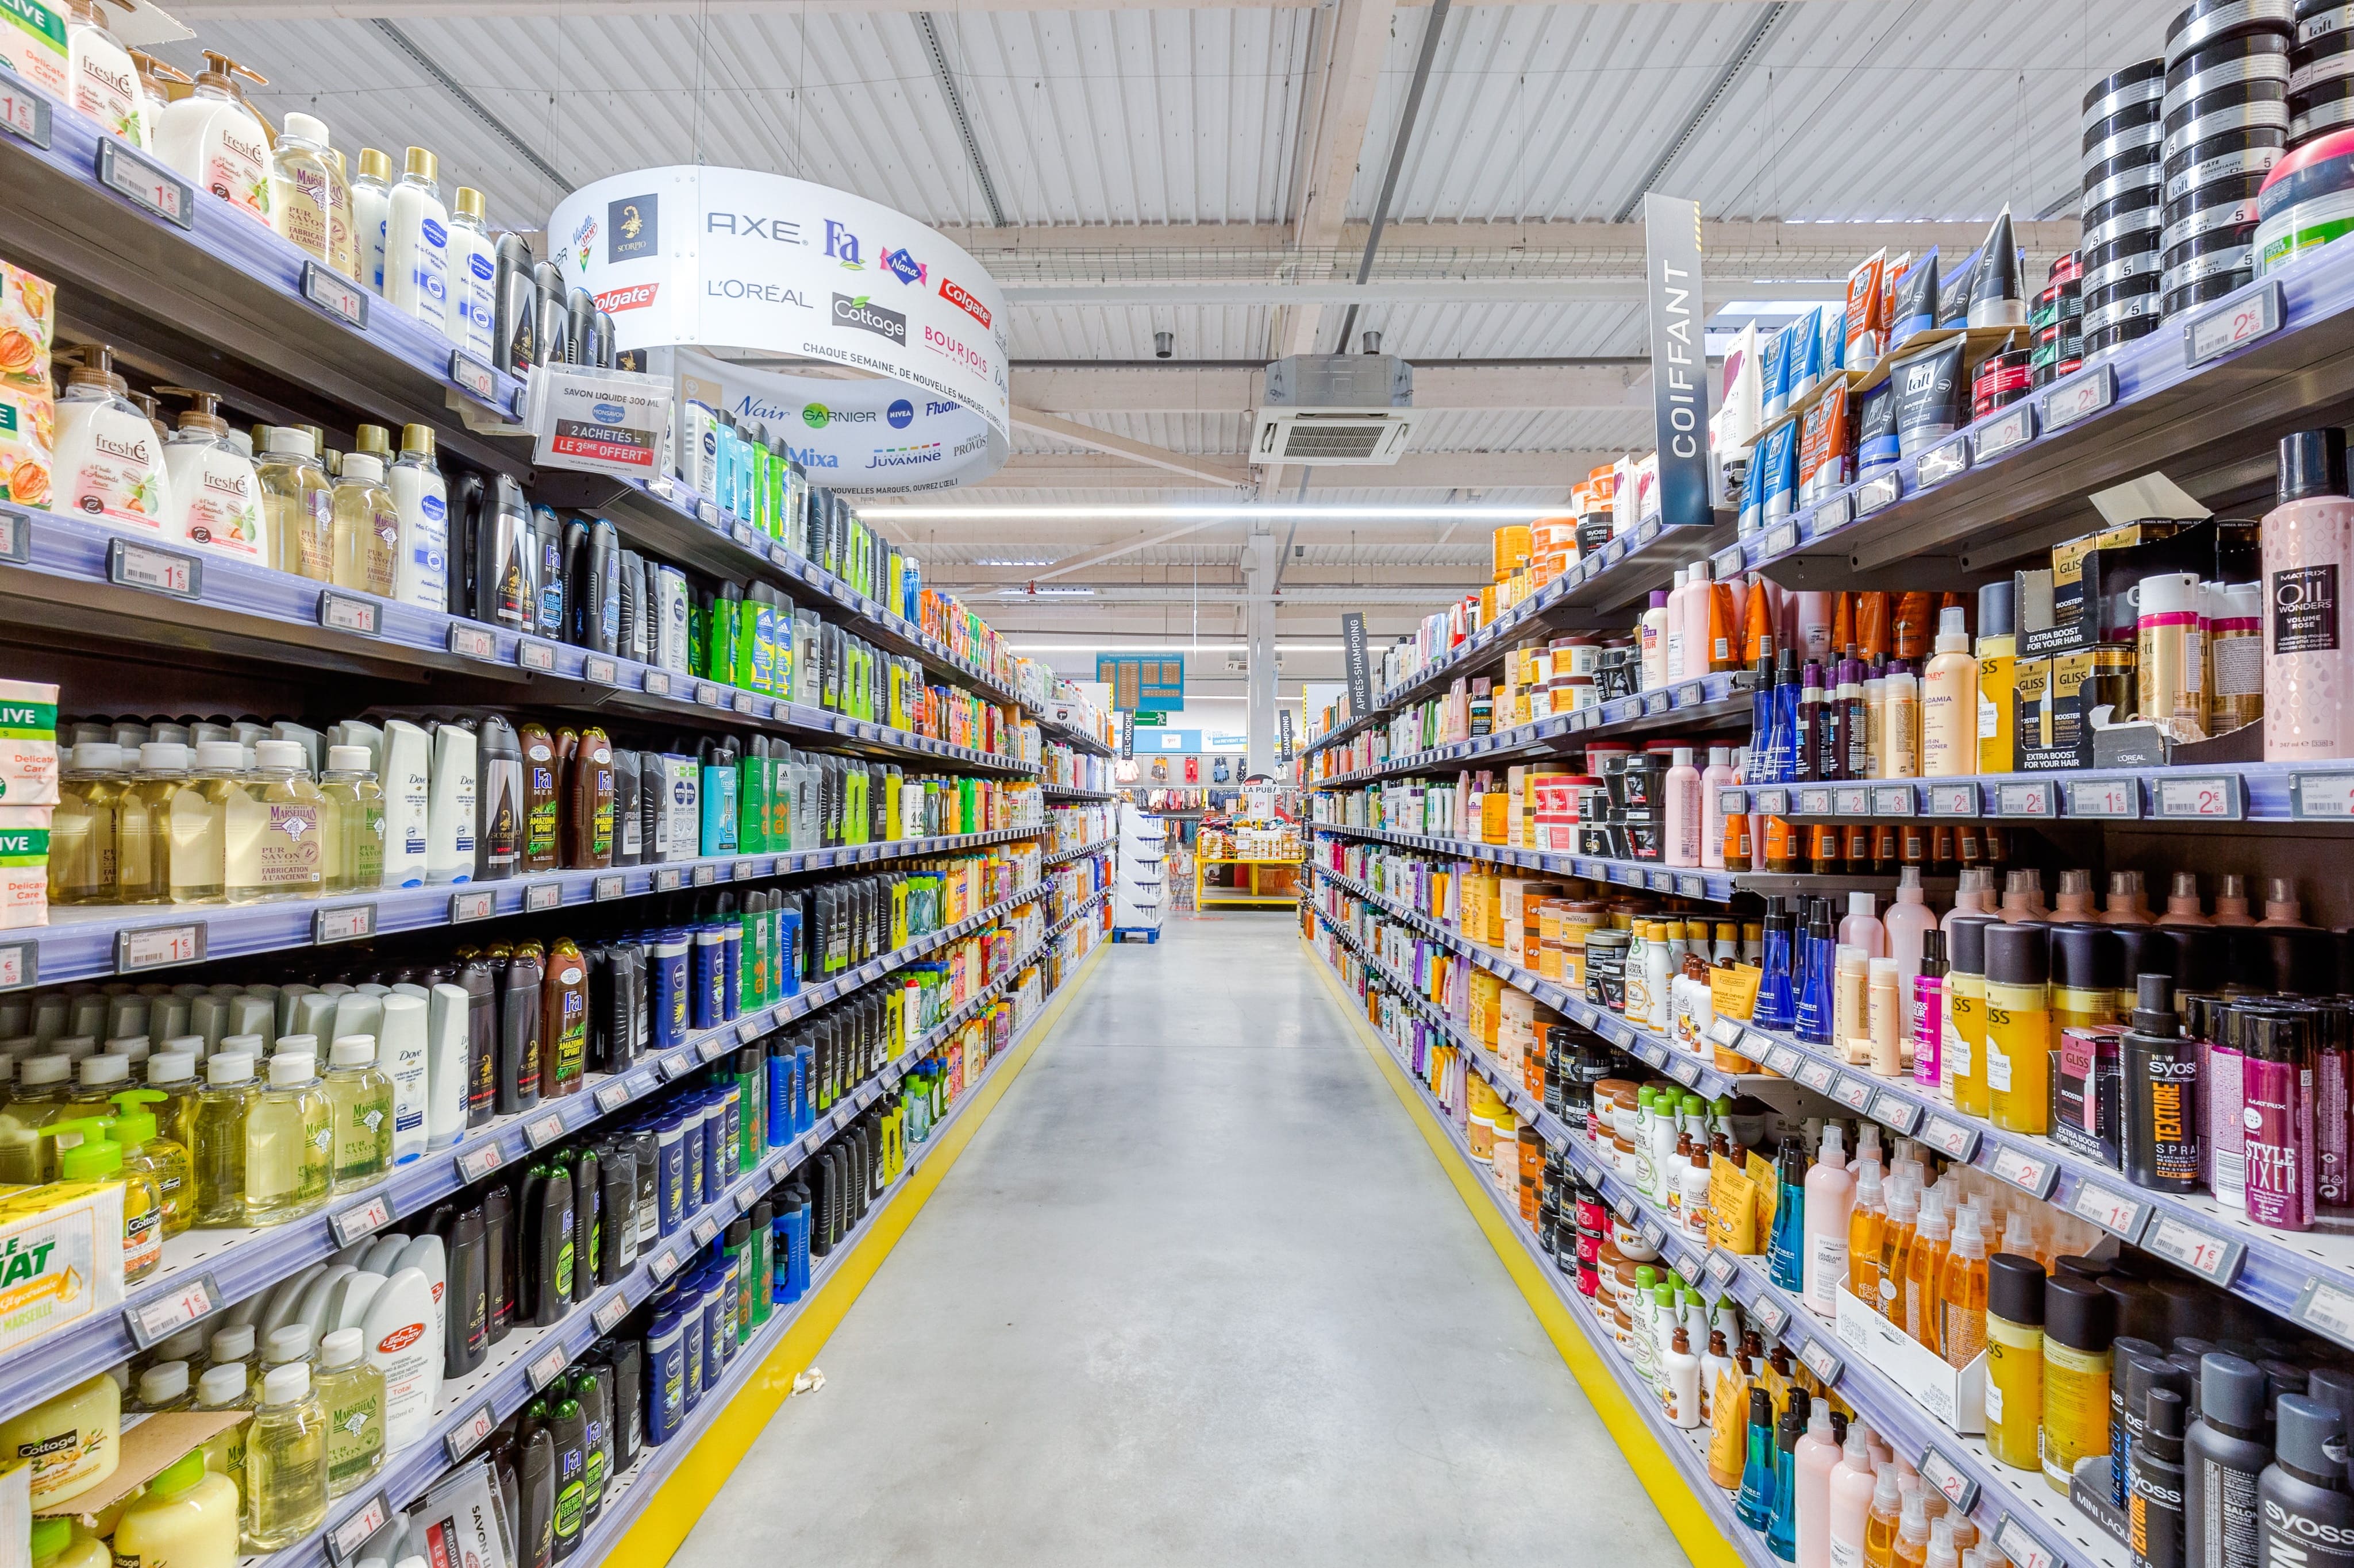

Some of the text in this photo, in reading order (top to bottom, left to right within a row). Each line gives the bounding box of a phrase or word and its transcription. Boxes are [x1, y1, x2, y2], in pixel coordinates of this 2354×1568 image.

[2309, 17, 2333, 36] taft
[26, 49, 66, 80] Delicate
[34, 66, 58, 84] Care
[2201, 158, 2220, 171] PÂTE
[2201, 160, 2241, 176] DENSIFIANTE
[2264, 157, 2271, 168] 5
[2172, 178, 2190, 197] taft
[582, 225, 597, 244] DOP
[707, 212, 801, 244] AXE
[618, 241, 647, 252] SCORPIO
[824, 218, 860, 264] Fa
[892, 259, 918, 277] Nana
[708, 280, 813, 309] L'ORÉAL
[1854, 279, 1868, 297] taft
[945, 282, 988, 324] Colgate
[1848, 297, 1863, 309] PURE
[835, 299, 905, 337] Cottage
[925, 326, 987, 373] BOURJOIS
[945, 353, 974, 373] PARIS
[1664, 259, 1697, 459] COIFFANT
[2060, 361, 2082, 373] NOUVEAU
[803, 343, 847, 360] CHAQUE
[851, 353, 897, 376] SEMAINE,
[900, 368, 911, 379] DE
[913, 373, 956, 398] NOUVELLES
[958, 392, 986, 417] MARQUES,
[1907, 373, 1932, 391] taft
[564, 388, 659, 407] SAVON LIQUIDE 300 ML
[1904, 397, 1933, 410] INVISIBLE
[593, 409, 625, 418] MONSAVON
[733, 396, 790, 420] Nair
[890, 410, 911, 418] NIVEA
[571, 426, 632, 444] 2 ACHETÉS
[966, 435, 982, 443] FRANCK
[559, 440, 573, 450] LE
[953, 436, 987, 456] PROVOST
[1770, 440, 1782, 456] taft
[789, 448, 838, 468] Mixa
[876, 485, 910, 494] MARQUES,
[913, 482, 937, 492] OUVREZ
[423, 500, 444, 514] Monsavon
[545, 545, 560, 568] Fa
[2280, 569, 2327, 581] MATRIX
[544, 600, 560, 611] FEELING
[545, 594, 560, 604] OCEAN
[2278, 600, 2332, 612] WONDERS
[2286, 615, 2321, 623] VOLUME
[2027, 634, 2082, 650] FOR YOUR HAIR
[2029, 628, 2078, 643] EXTRA BOOST
[1351, 619, 1366, 710] APRÈS-SHAMPOING
[2019, 677, 2044, 691] GLISS
[2055, 712, 2081, 721] BOOSTER
[1124, 712, 1133, 756] GEL-DOUCHE
[2026, 752, 2076, 761] EXTRA BOOST
[2039, 759, 2060, 768] YOUR
[2061, 758, 2080, 766] HAIR
[409, 774, 426, 785] Dove
[534, 768, 552, 789] Fa
[2199, 791, 2213, 812] 2
[2214, 792, 2220, 803] €
[270, 807, 317, 821] MARSEILLAIS
[530, 816, 556, 826] AMAZONIA
[536, 823, 552, 833] SPIRIT
[261, 866, 309, 874] FABRICATION
[8, 882, 47, 891] Delicate
[17, 891, 40, 899] Care
[170, 939, 178, 960] 1
[182, 938, 189, 947] €
[1718, 977, 1745, 987] Evoluderm
[564, 991, 582, 1013] Fa
[559, 1038, 584, 1050] AMAZONIA
[564, 1047, 580, 1057] SPIRIT
[399, 1049, 422, 1061] Dove
[2066, 1053, 2088, 1068] GLISS
[2152, 1054, 2174, 1062] NEW
[2061, 1090, 2084, 1103] BOOSTER
[2248, 1097, 2286, 1110] MATRIX
[353, 1097, 390, 1116] MARSEILLAIS
[2153, 1082, 2180, 1142] TEXTURE
[2058, 1126, 2101, 1149] EXTRA BOOST
[2056, 1134, 2103, 1159] FOR YOUR HAIR
[2156, 1143, 2197, 1155] SPRA
[2245, 1140, 2295, 1166] STYLE
[2245, 1159, 2296, 1194] FIXER
[1819, 1239, 1849, 1249] BYPHASSE
[1818, 1257, 1836, 1265] EXPRESS
[2194, 1243, 2216, 1270] 1 € 99
[3, 1302, 53, 1332] MARSEILLE
[1840, 1312, 1867, 1337] KÉRATINE
[382, 1328, 424, 1348] Lifebuoy
[1841, 1319, 1868, 1349] LIQUIDE
[1874, 1316, 1906, 1347] BYPHASSE
[391, 1355, 412, 1366] HYGIENIC
[393, 1384, 411, 1396] Total
[333, 1394, 376, 1424] MARSEILLAIS
[20, 1435, 76, 1457] Cottage
[563, 1449, 582, 1473] Fa
[563, 1467, 582, 1482] MEN
[2128, 1471, 2181, 1502] syoss
[560, 1494, 582, 1510] ENERGY
[560, 1500, 582, 1520] FEELING
[2076, 1491, 2130, 1543] MINI LAQU
[2224, 1503, 2258, 1520] SALON
[2224, 1511, 2253, 1524] MOUSSE
[472, 1504, 487, 1549] SAVON
[2265, 1499, 2354, 1543] syoss
